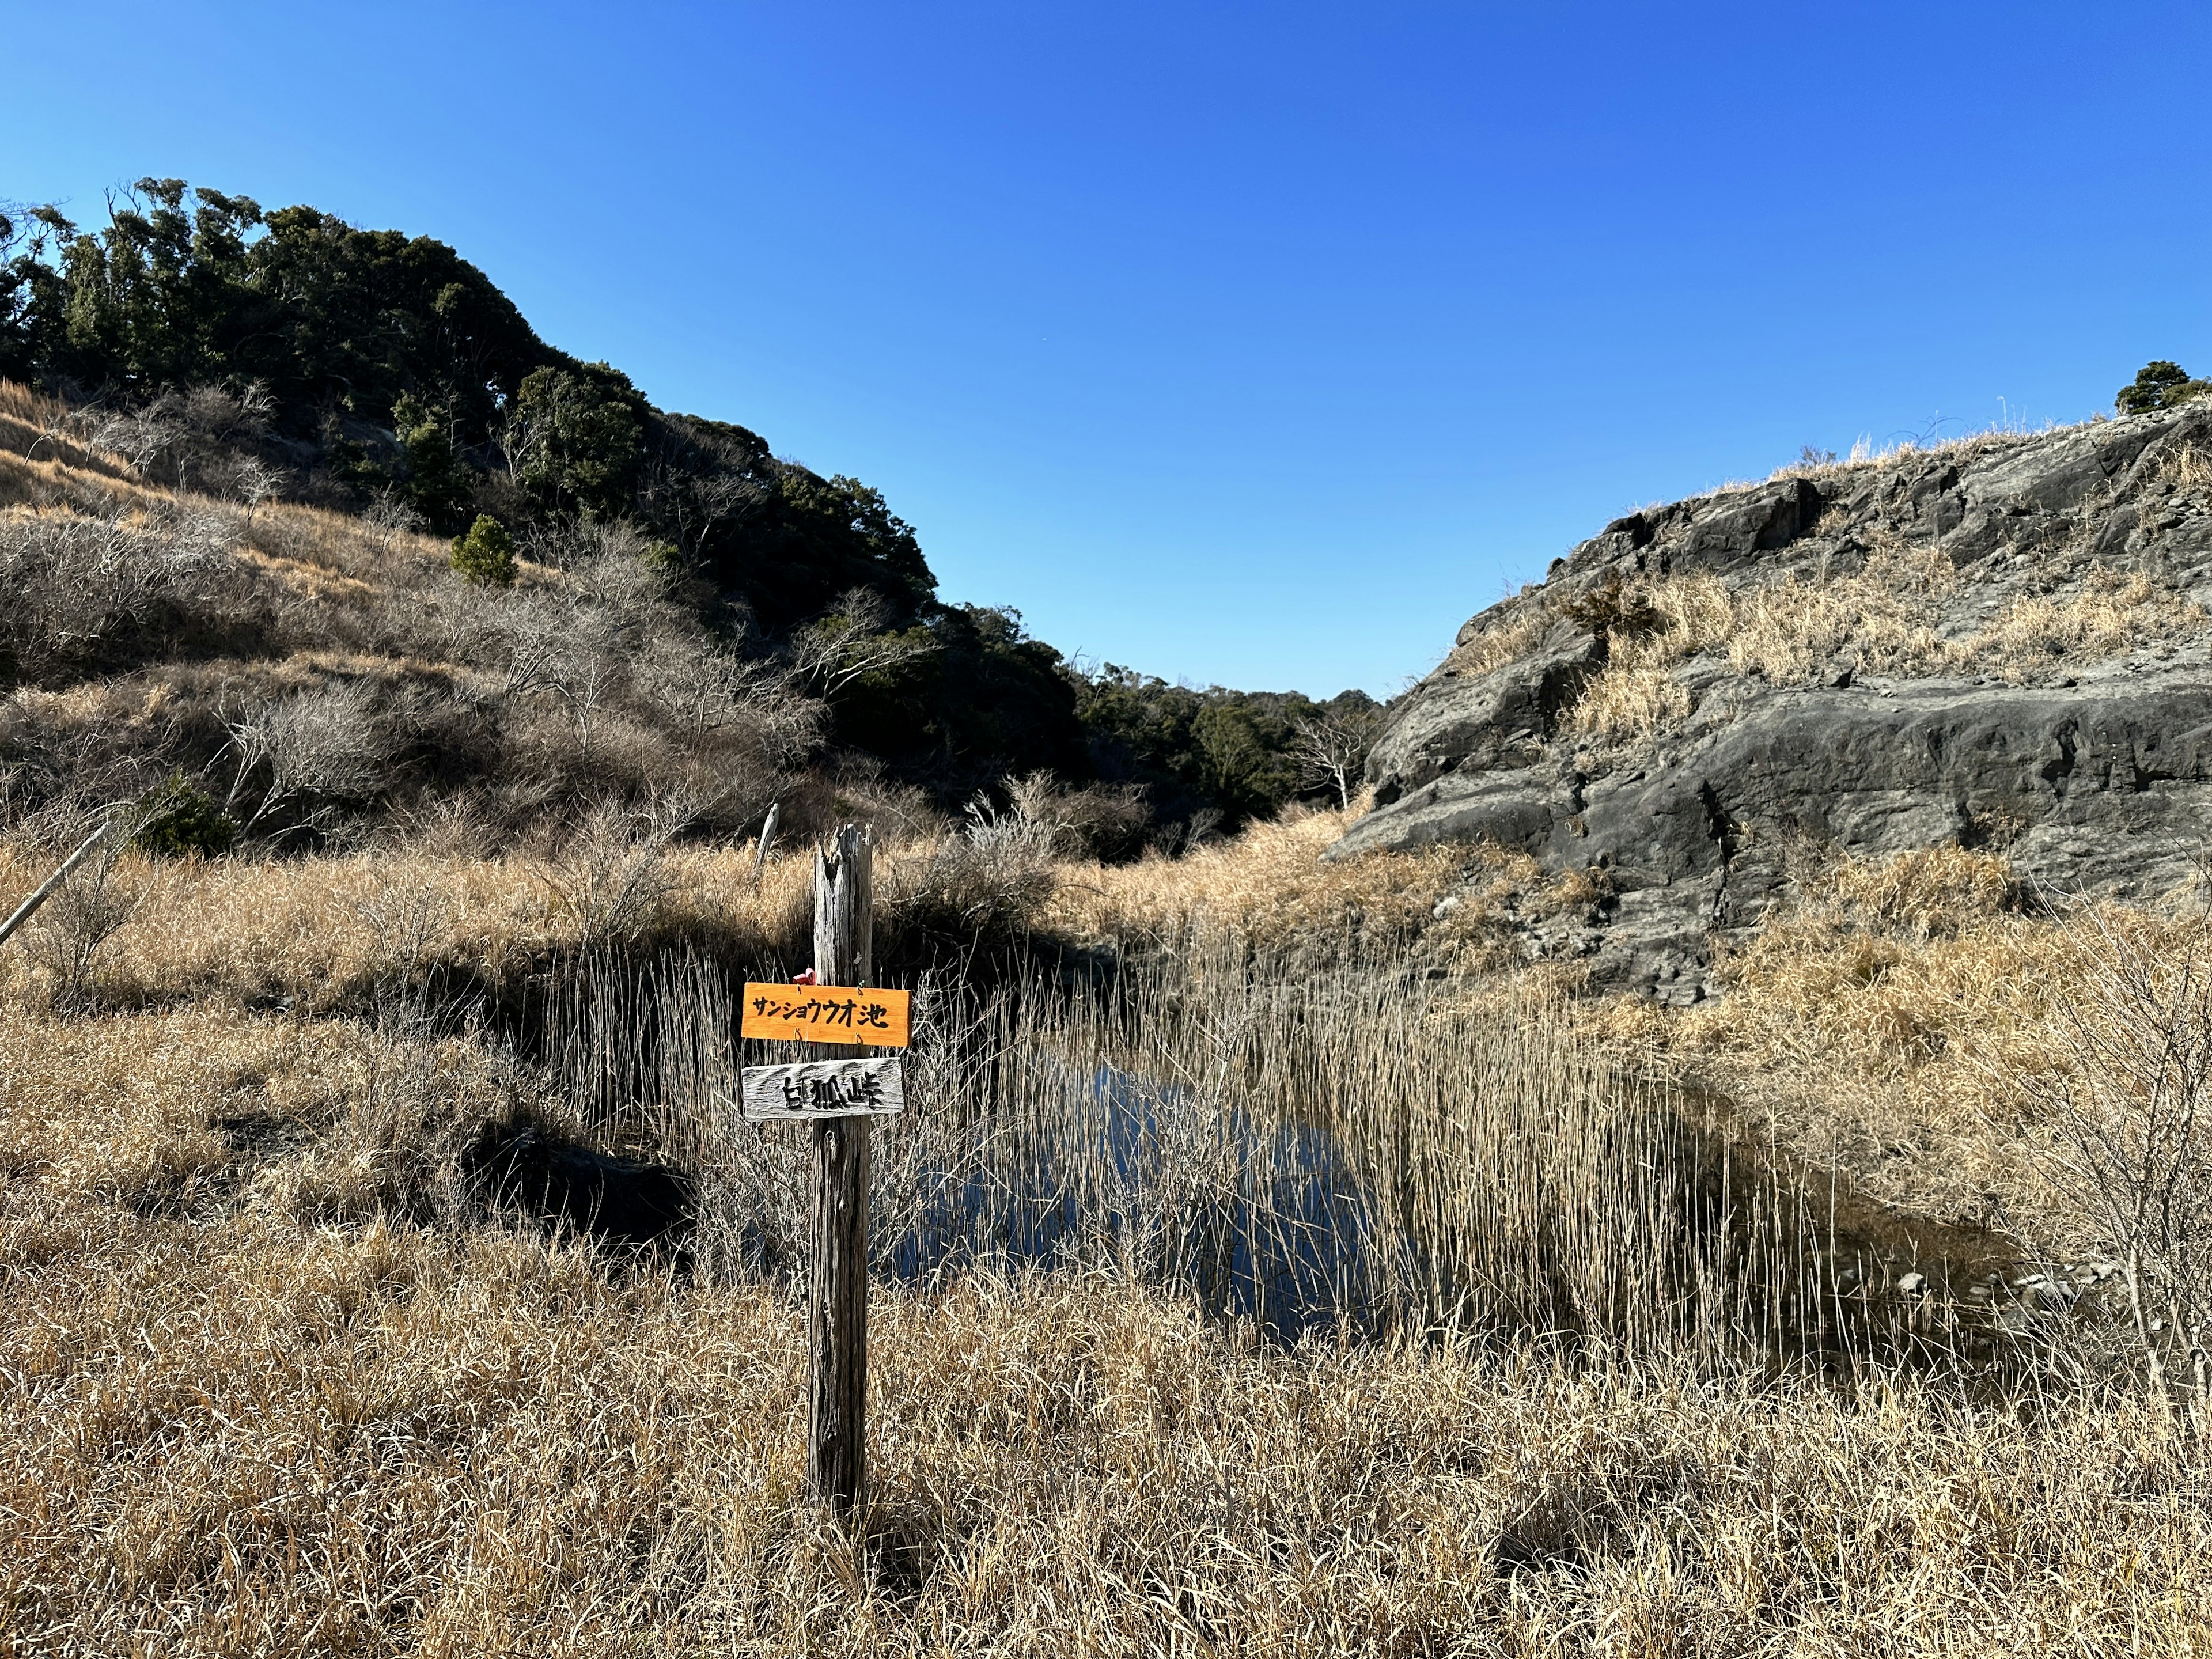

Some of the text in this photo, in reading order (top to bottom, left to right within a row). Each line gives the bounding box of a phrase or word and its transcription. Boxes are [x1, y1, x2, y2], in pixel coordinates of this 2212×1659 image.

[753, 996, 889, 1028] サンショウウオ池
[782, 1071, 885, 1111] 白狐峠
